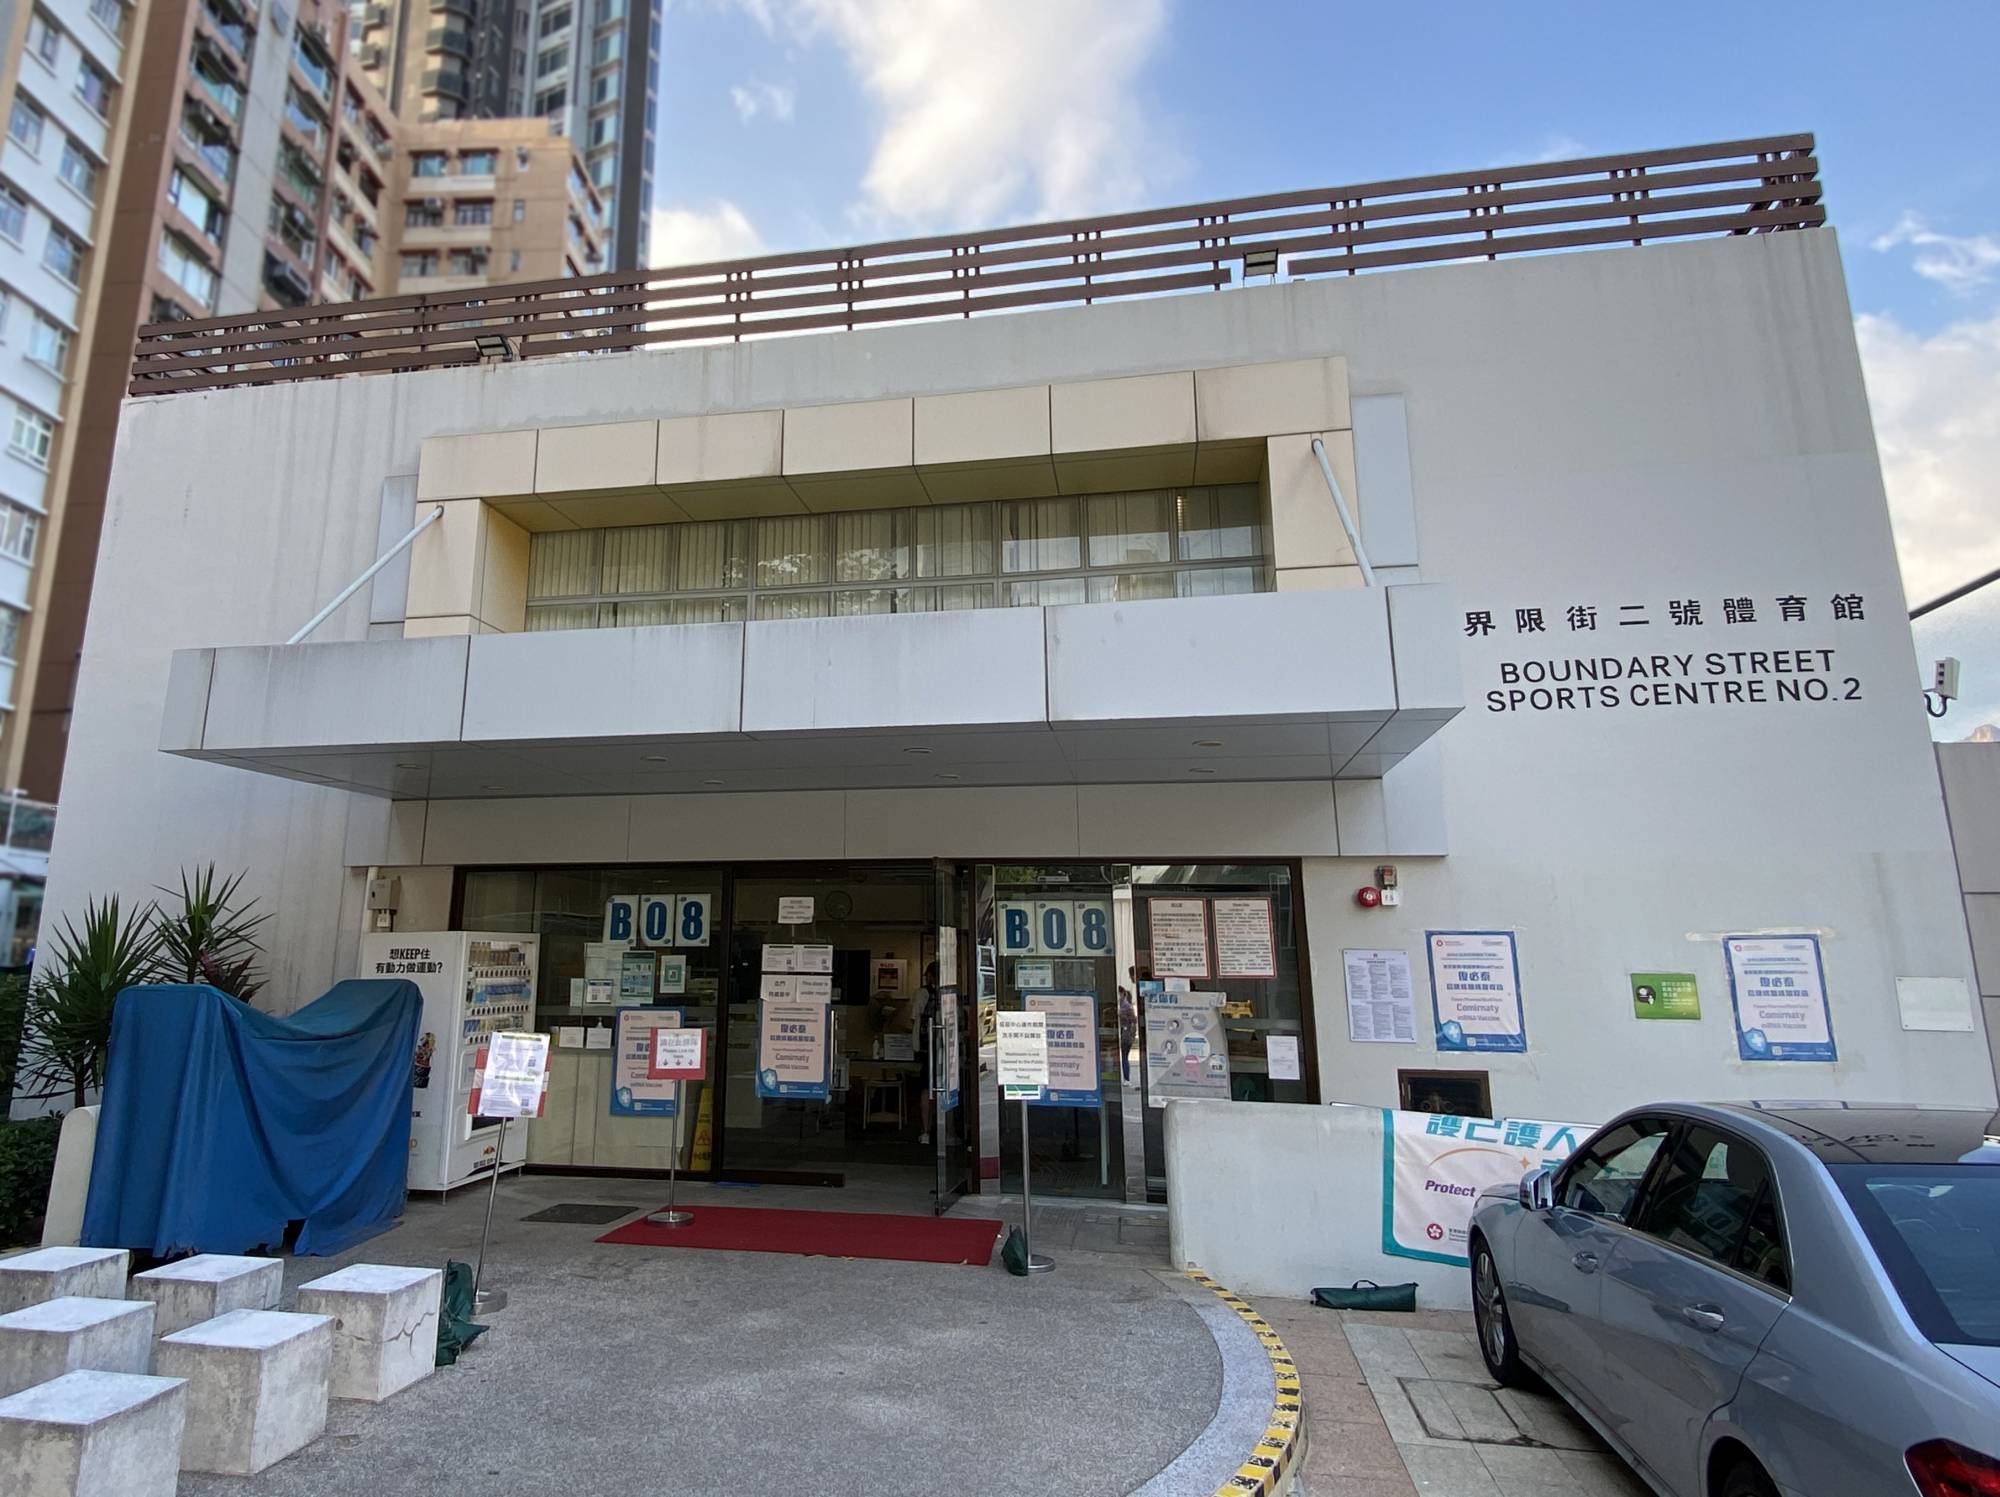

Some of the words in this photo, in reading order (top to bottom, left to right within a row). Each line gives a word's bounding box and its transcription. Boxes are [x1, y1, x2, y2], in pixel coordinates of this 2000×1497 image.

[1463, 594, 1866, 637] 界限街二號體育館
[1501, 653, 1694, 684] BOUNDARY
[1705, 649, 1836, 676] STREET
[1486, 685, 1621, 712] SPORTS
[1630, 679, 1767, 707] CENTRE
[389, 947, 431, 961] 想KEEP住
[375, 961, 443, 974] 有動力做運動?
[1456, 1003, 1500, 1014] Comirnaty
[1759, 1010, 1806, 1022] Comirnaty
[1425, 1179, 1476, 1198] Protect
